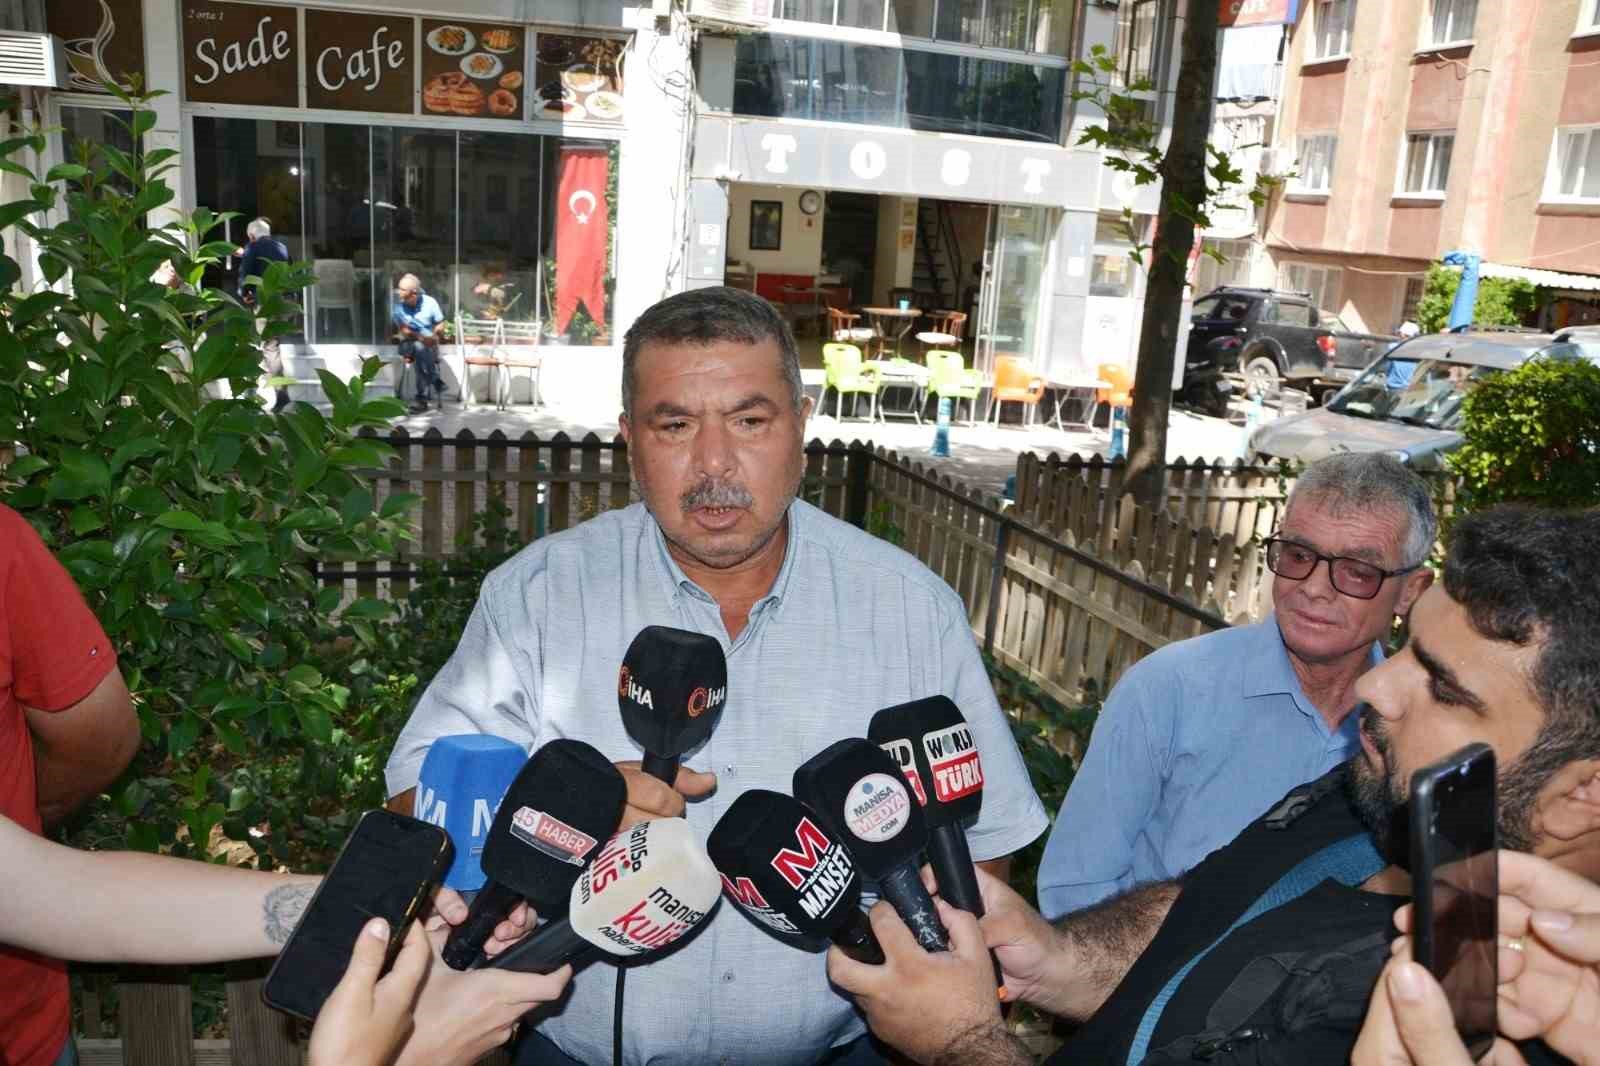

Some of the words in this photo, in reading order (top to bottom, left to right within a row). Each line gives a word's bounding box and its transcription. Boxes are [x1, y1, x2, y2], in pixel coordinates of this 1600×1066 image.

[194, 16, 290, 84] Sade
[316, 26, 405, 91] Cafe
[936, 757, 982, 796] TÜRK
[538, 820, 587, 853] HABER
